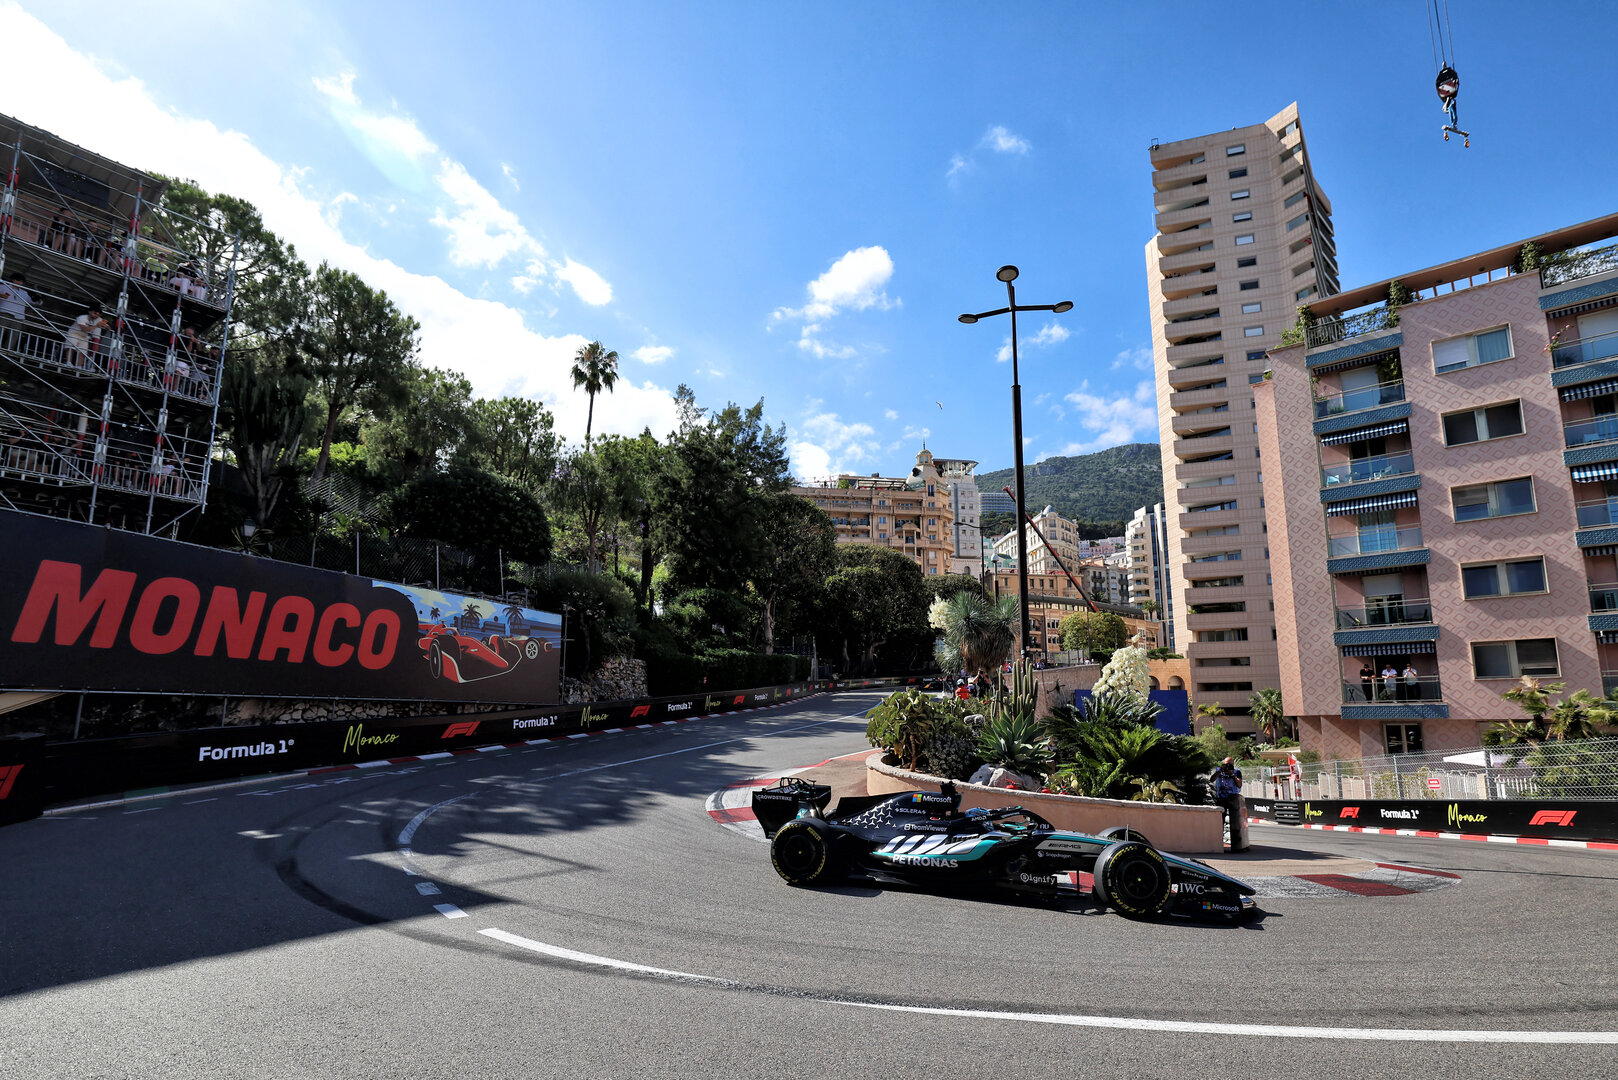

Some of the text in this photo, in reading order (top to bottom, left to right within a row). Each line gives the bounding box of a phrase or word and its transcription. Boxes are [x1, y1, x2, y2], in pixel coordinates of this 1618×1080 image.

[11, 559, 400, 670] MONACO
[668, 703, 687, 711] Formula
[581, 706, 609, 728] Monaco
[513, 718, 549, 729] Formula
[343, 723, 399, 755] Monaco
[199, 742, 274, 761] Formula
[1381, 809, 1410, 819] Formula
[1448, 803, 1488, 829] Monaco
[911, 824, 947, 832] TeamViewer
[892, 854, 958, 868] PETRONAS
[1180, 883, 1205, 894] IWC
[1212, 904, 1239, 912] Microsoft
